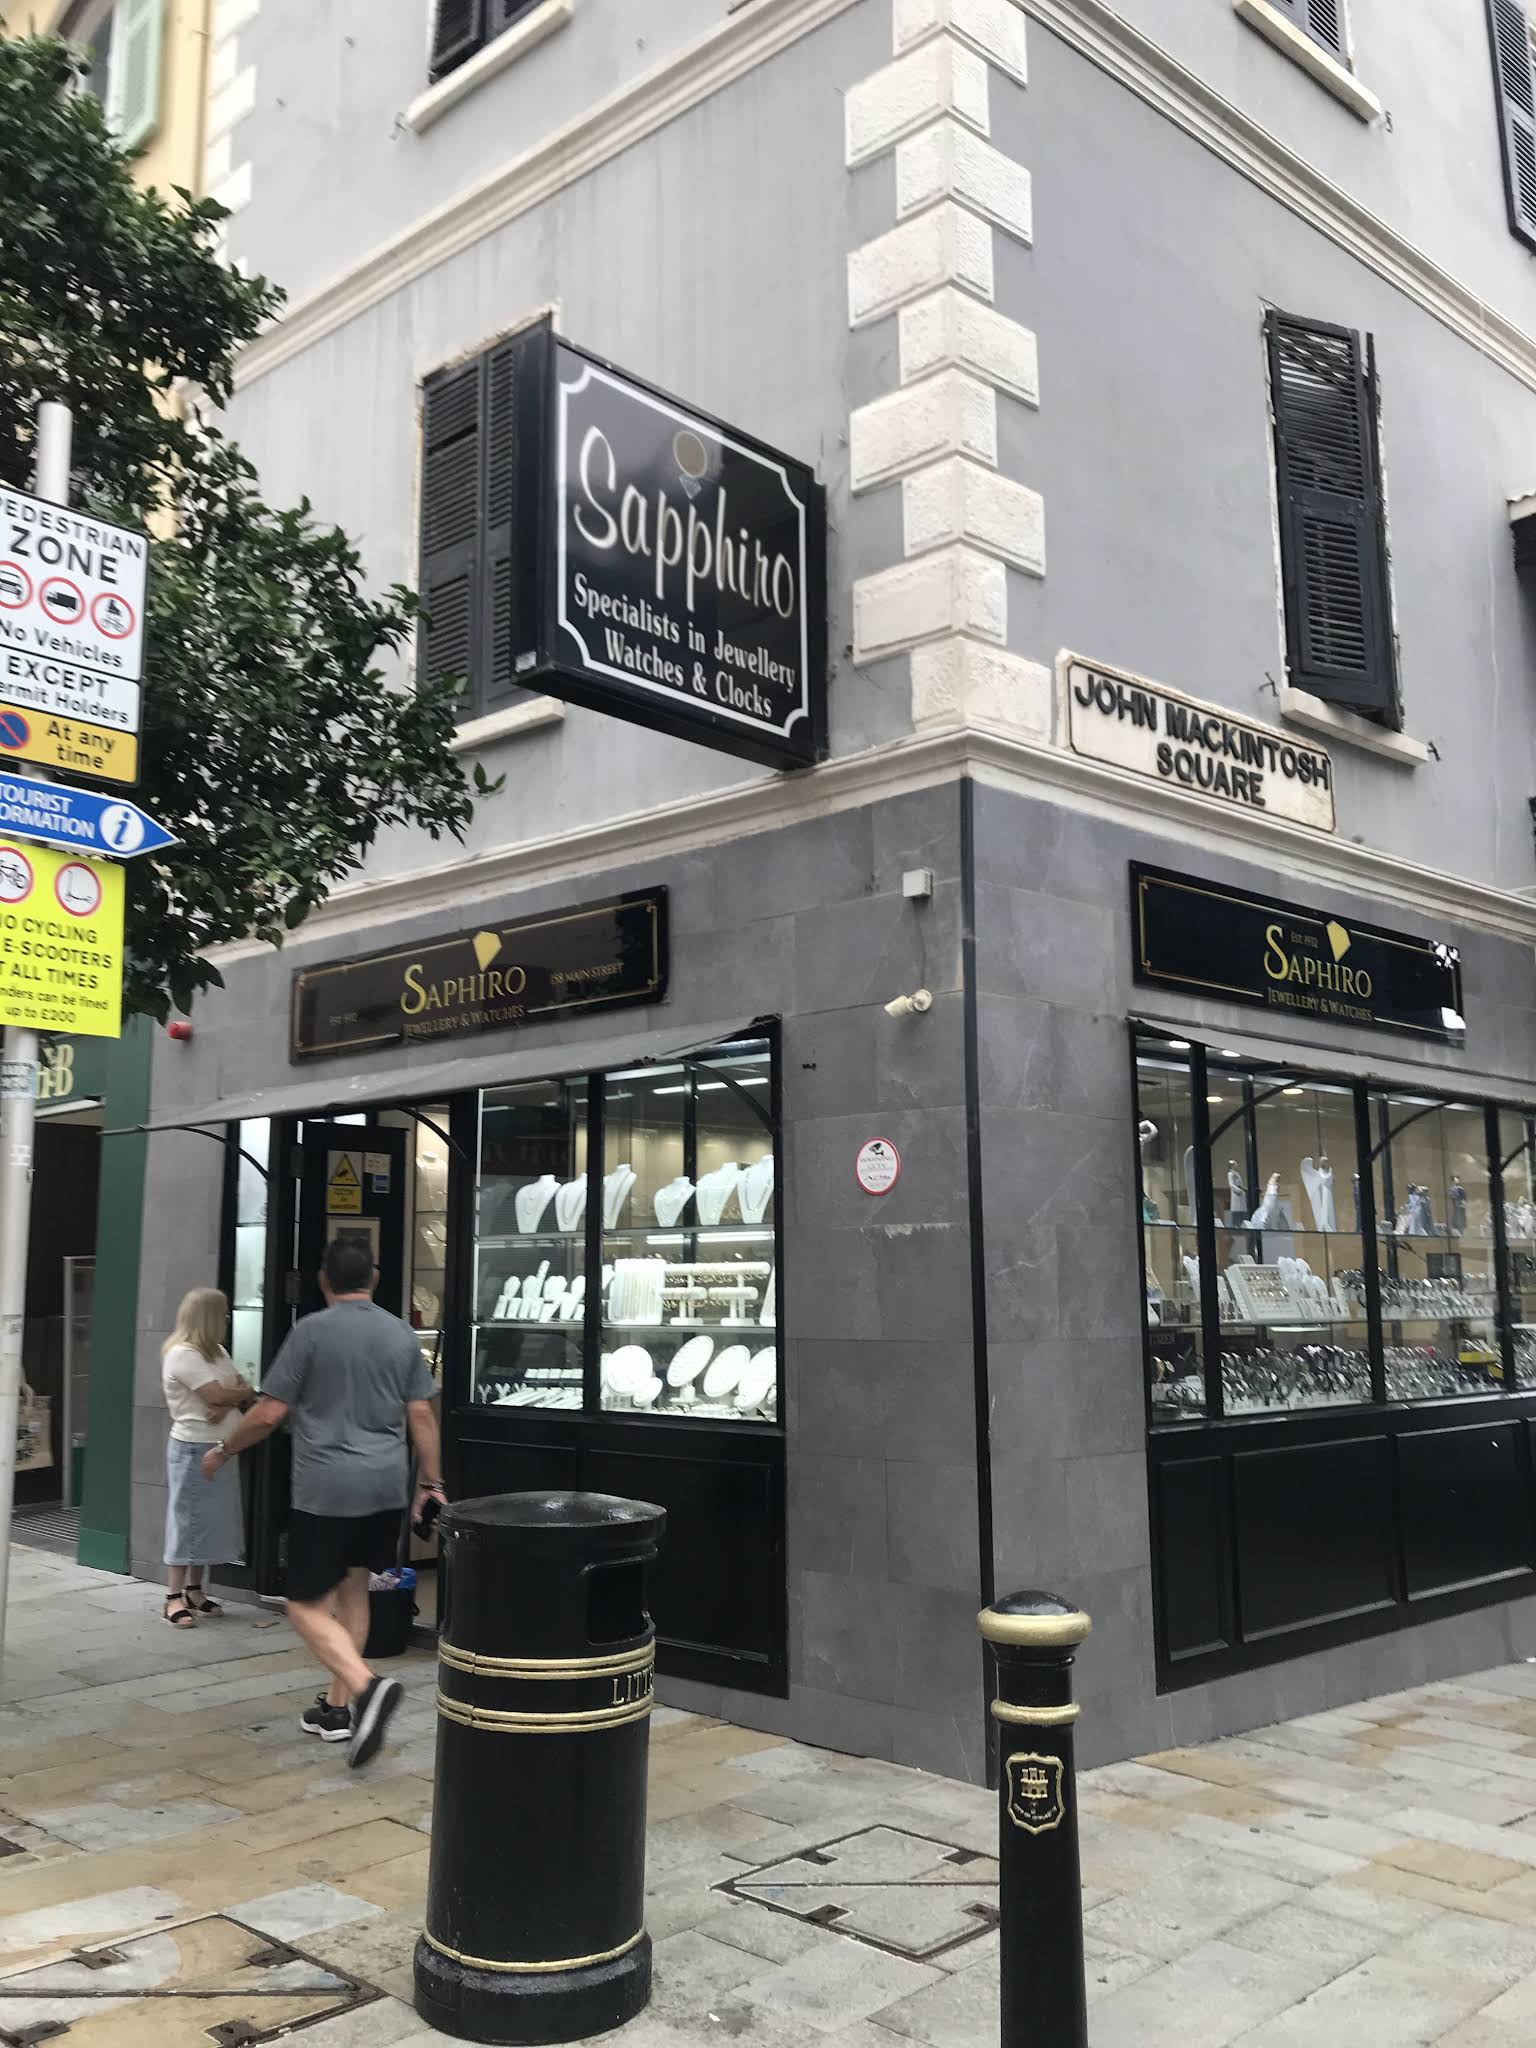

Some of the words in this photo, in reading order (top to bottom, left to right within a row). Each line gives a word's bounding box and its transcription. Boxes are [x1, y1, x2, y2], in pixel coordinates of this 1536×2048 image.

[0, 496, 141, 559] EDESTRIAN
[573, 425, 795, 619] Sapphiro
[10, 524, 119, 584] ZONE
[34, 627, 123, 668] Vehicles
[573, 572, 681, 643] Specialists
[688, 621, 706, 655] in
[713, 630, 796, 693] Jewellery
[7, 654, 110, 698] EXCEPT
[603, 627, 684, 686] Watches
[691, 667, 708, 695] &
[715, 671, 772, 717] Clocks
[55, 691, 129, 724] Holders
[46, 720, 72, 741] At
[79, 731, 117, 753] any
[1074, 674, 1158, 731] JOHN
[1165, 702, 1329, 790] MACKINTOSH
[56, 743, 104, 769] time
[1157, 742, 1266, 807] SQUARE
[0, 913, 18, 930] O
[22, 917, 98, 945] CYCLING
[3, 937, 113, 969] E-SCOOTERS
[1263, 923, 1373, 998] SAPHIRO
[10, 962, 43, 981] ALL
[46, 967, 99, 989] TIMES
[401, 964, 527, 1015] SAPHIRO
[4, 1006, 22, 1018] up
[24, 1005, 38, 1018] to
[41, 1008, 78, 1024] £200
[36, 991, 59, 1003] can
[61, 992, 77, 1006] be
[79, 995, 109, 1011] fined
